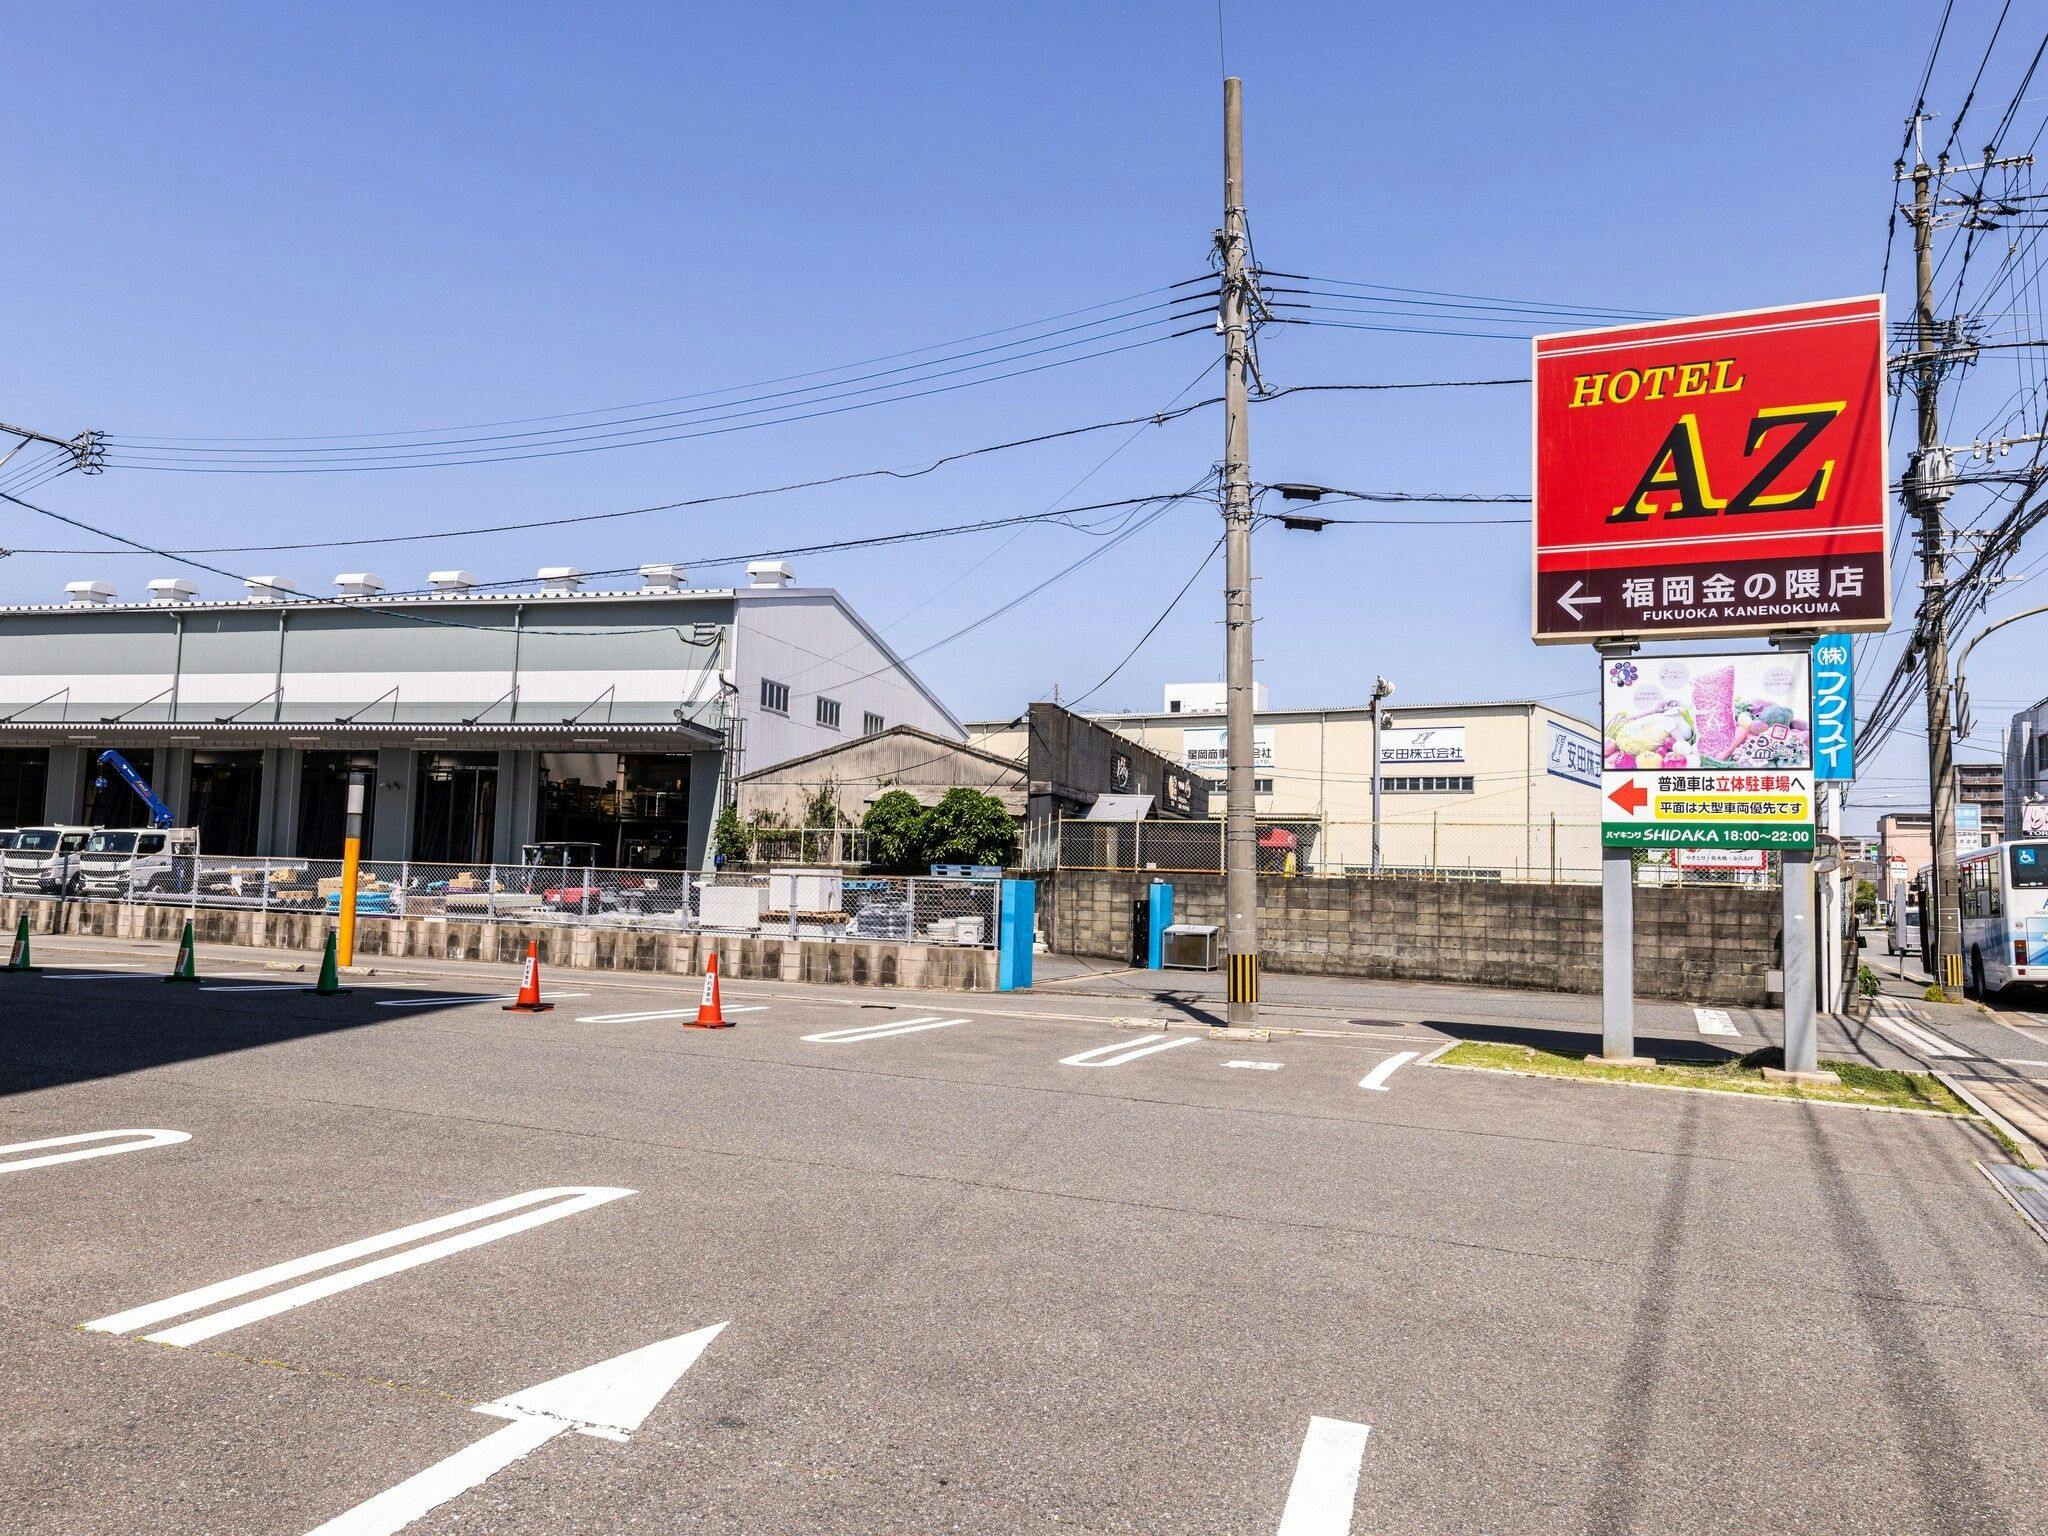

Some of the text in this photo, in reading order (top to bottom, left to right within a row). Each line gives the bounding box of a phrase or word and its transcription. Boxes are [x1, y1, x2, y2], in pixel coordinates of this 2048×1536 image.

[1568, 358, 1746, 409] HOTEL
[1604, 400, 1847, 525] AZ
[1622, 565, 1864, 608] 福岡金の隈店
[1643, 602, 1840, 621] FUKUOKA KANENOKUMA
[1381, 747, 1463, 760] 安田株式会社
[1658, 775, 1806, 792] 普通車は立体駐車場へ
[1660, 801, 1802, 815] 平面は大型車両優先です
[1605, 831, 1642, 840] バイキング
[1643, 828, 1719, 842] SHIDAKA
